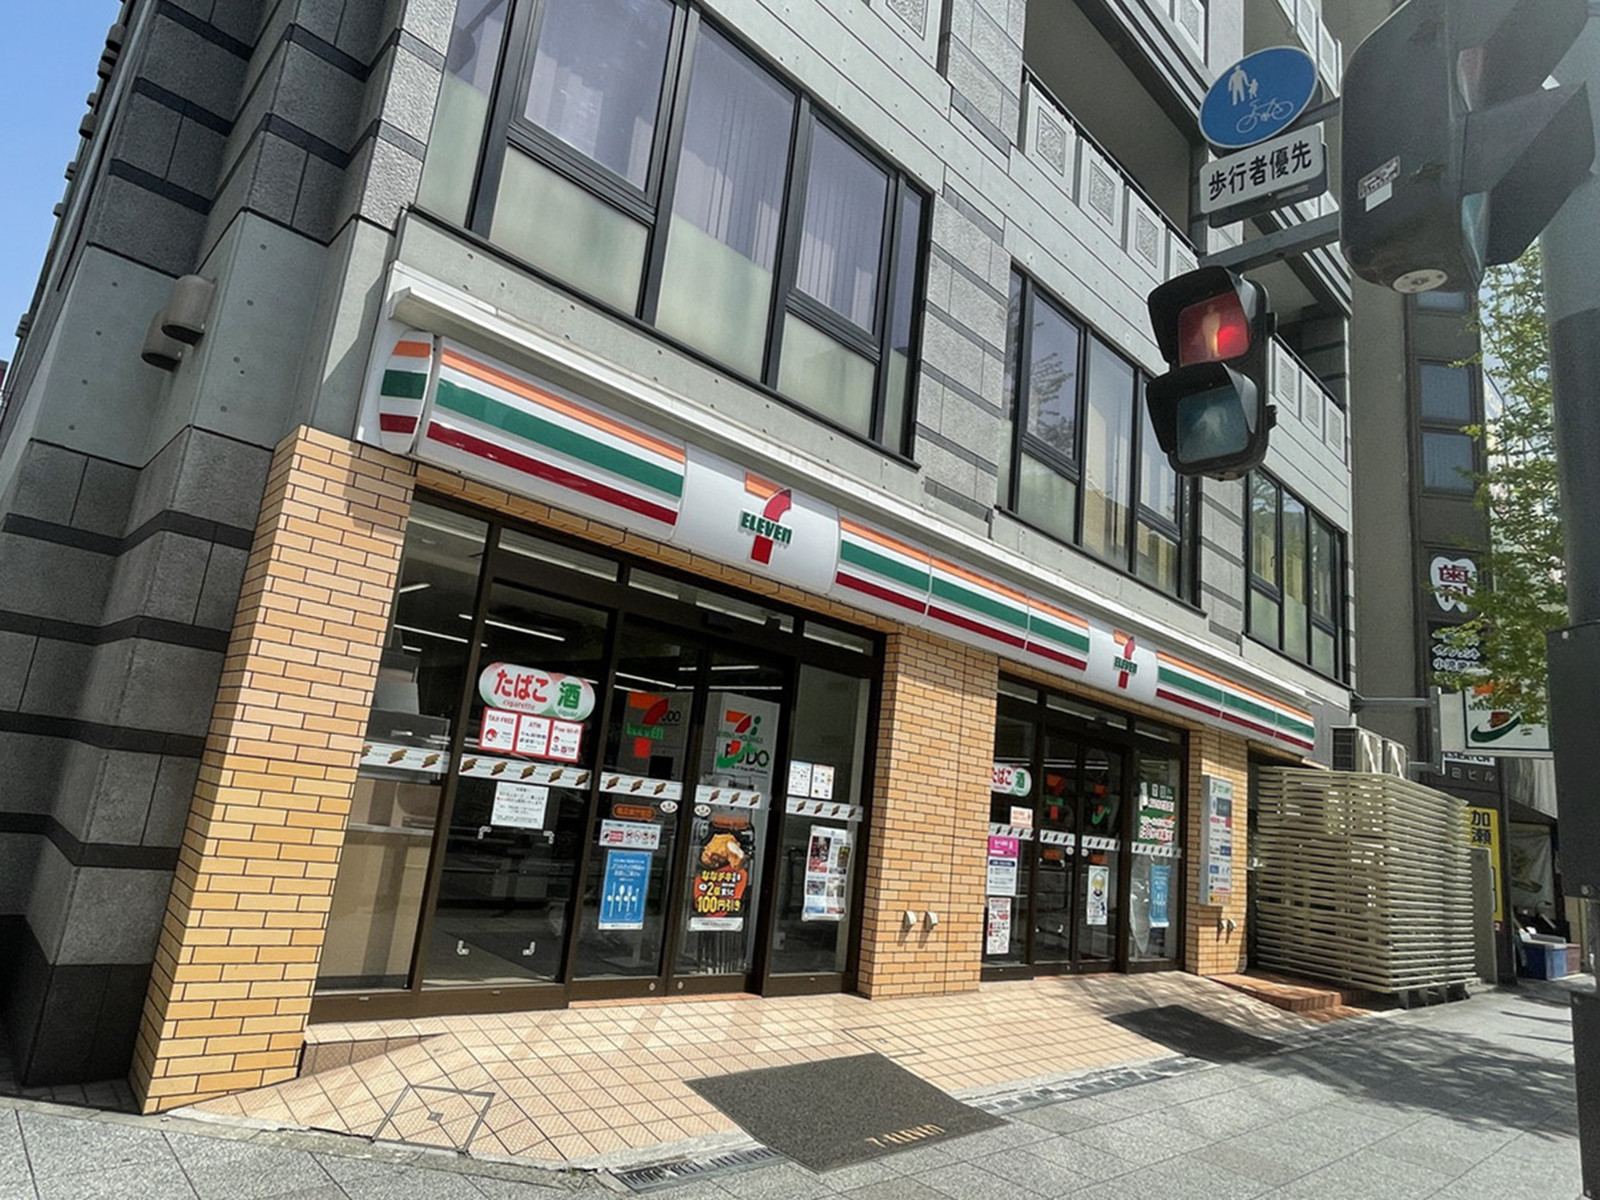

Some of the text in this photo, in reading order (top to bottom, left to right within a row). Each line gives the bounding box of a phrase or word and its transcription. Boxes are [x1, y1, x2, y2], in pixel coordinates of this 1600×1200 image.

[1208, 139, 1312, 201] 歩行者優先
[494, 669, 582, 709] たばこ 酒
[1470, 810, 1492, 845] 加瀬
[697, 895, 742, 913] 100円引き
